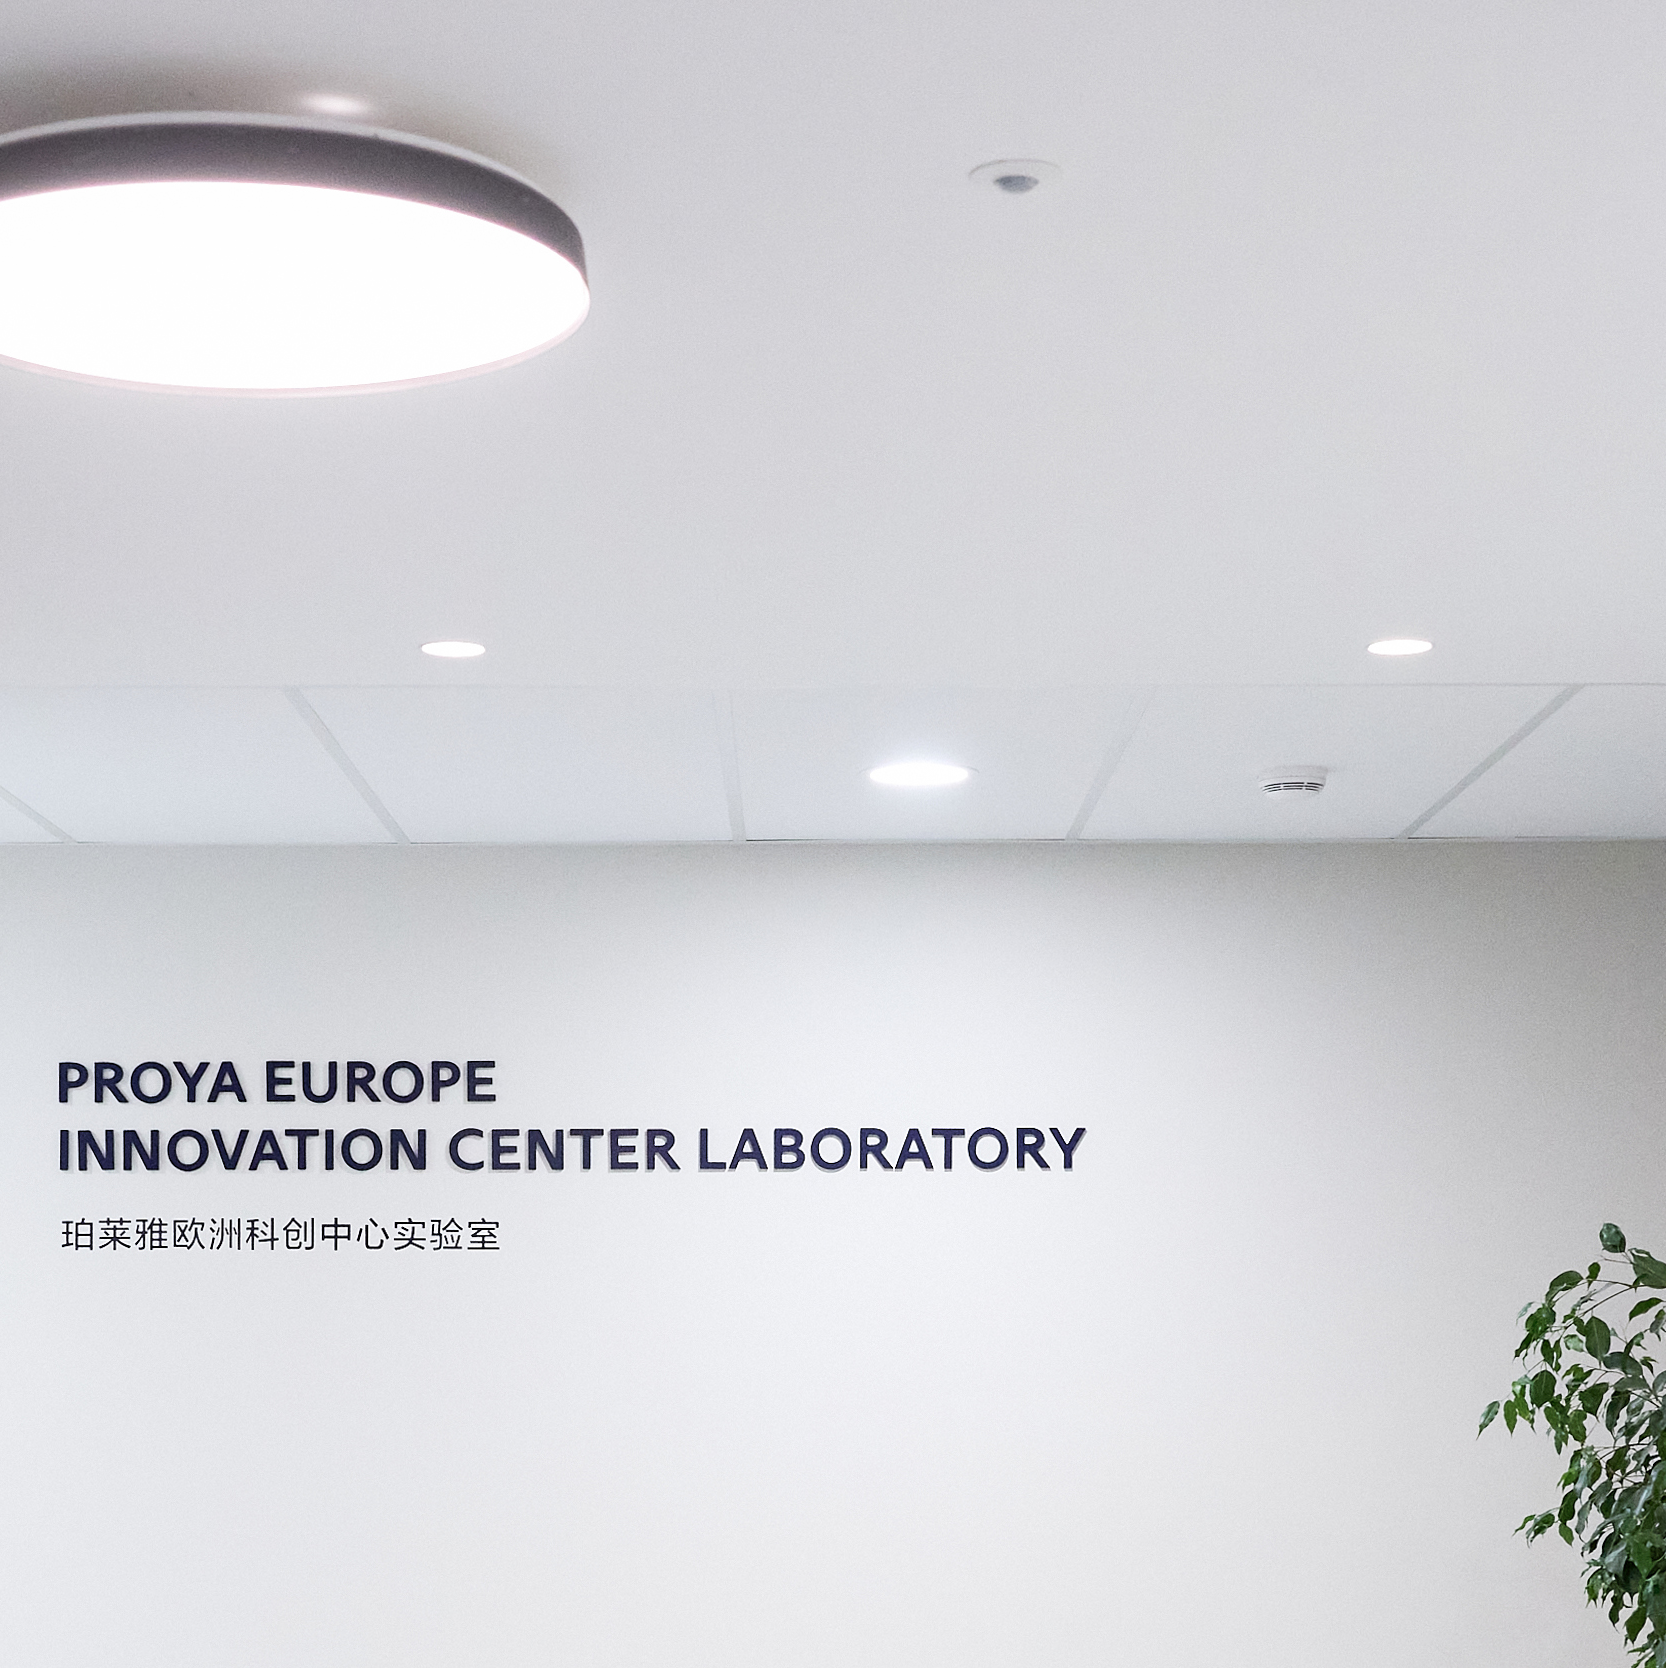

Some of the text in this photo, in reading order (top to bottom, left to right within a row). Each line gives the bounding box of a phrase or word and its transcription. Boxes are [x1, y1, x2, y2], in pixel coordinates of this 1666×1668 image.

[57, 1060, 497, 1106] PROYA EUROPE
[58, 1126, 1086, 1173] INNOVATION CENTER LABORATORY
[61, 1217, 501, 1252] 珀莱雅欧洲科创中心实验室
